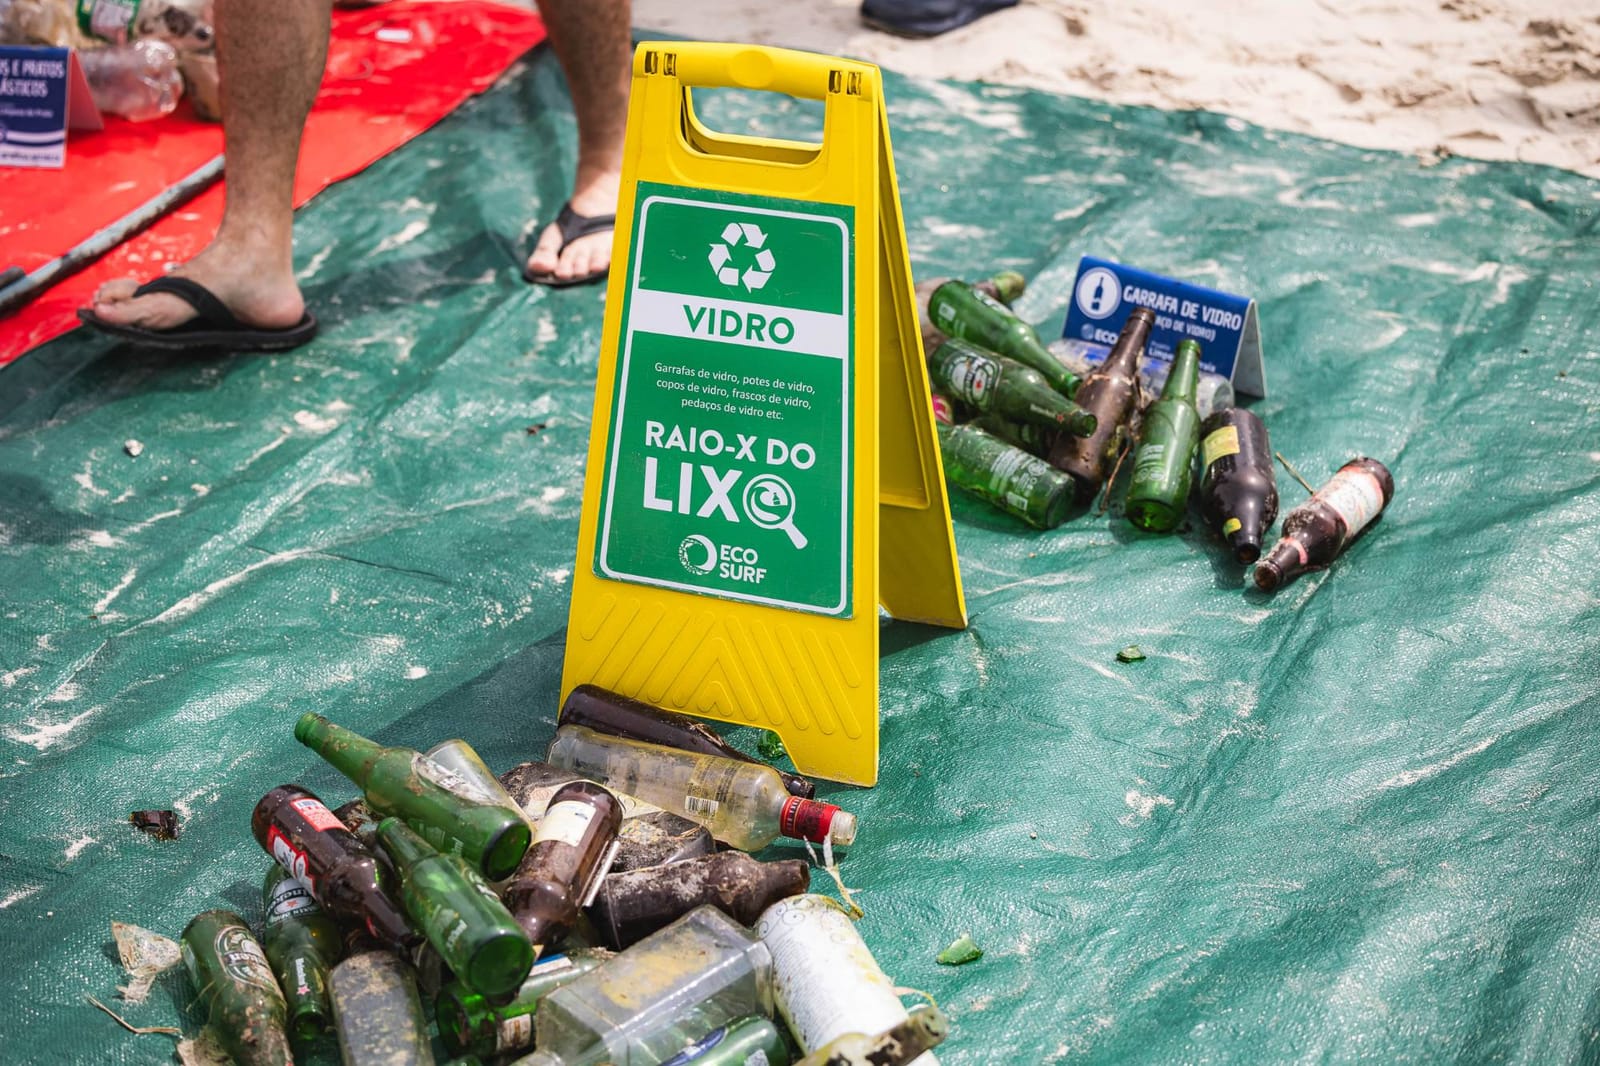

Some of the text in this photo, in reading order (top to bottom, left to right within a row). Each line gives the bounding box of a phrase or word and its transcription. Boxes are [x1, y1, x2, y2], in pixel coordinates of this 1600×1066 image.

[0, 77, 48, 97] ÁSTICOS
[1123, 285, 1242, 331] GARRAFA DE VIDRO
[683, 304, 795, 345] VIDRO
[654, 362, 816, 395] Garrafas de vidro, potes de vidro,
[656, 379, 812, 410] copos de vidro, frascos de vidro,
[681, 398, 784, 420] pedaços de vidro etc.
[645, 420, 816, 470] RAIO-X DO
[720, 544, 758, 565] ECO
[719, 563, 767, 584] SURF
